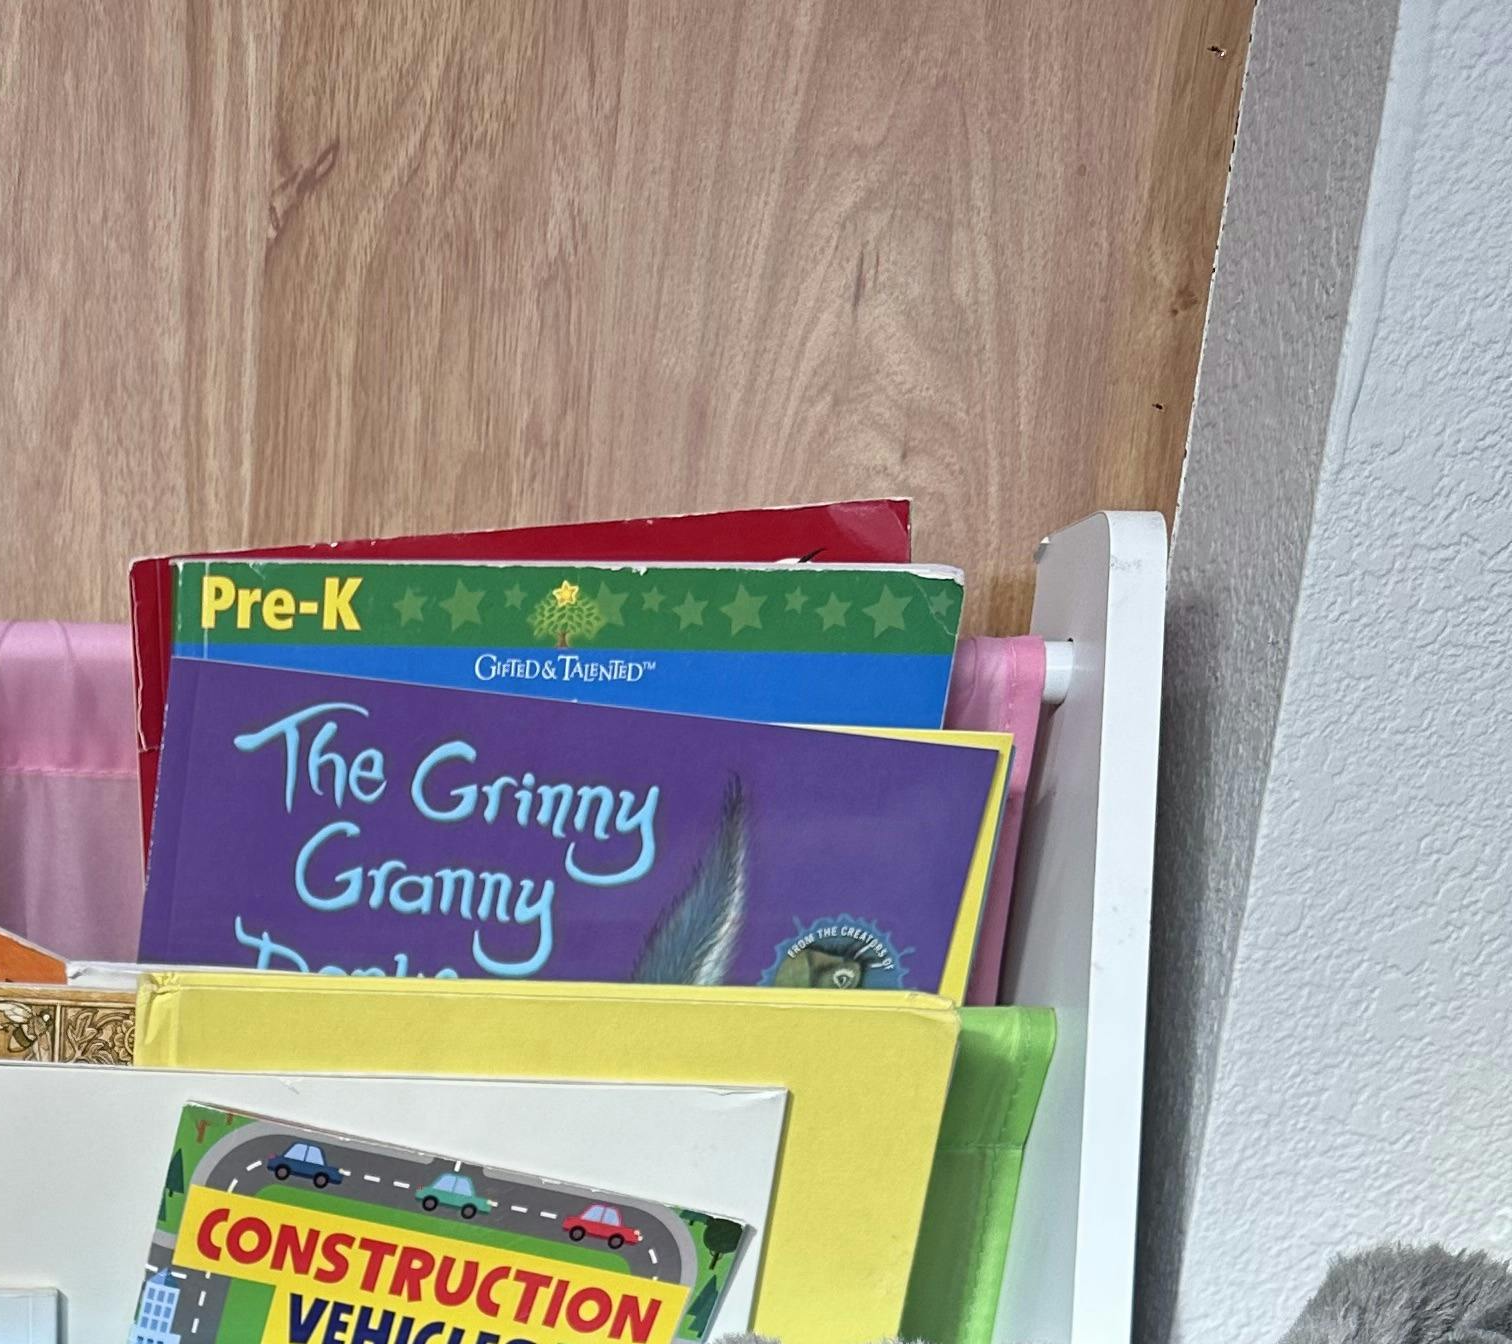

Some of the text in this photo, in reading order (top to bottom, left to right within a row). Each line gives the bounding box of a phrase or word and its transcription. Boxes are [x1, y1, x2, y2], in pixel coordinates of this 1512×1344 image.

[200, 575, 364, 632] Pre-K
[233, 702, 660, 886] The Grinny
[295, 821, 555, 978] Granny
[787, 925, 896, 971] FROM THE CREATORS OF
[196, 1207, 662, 1344] CONSTRUCTION
